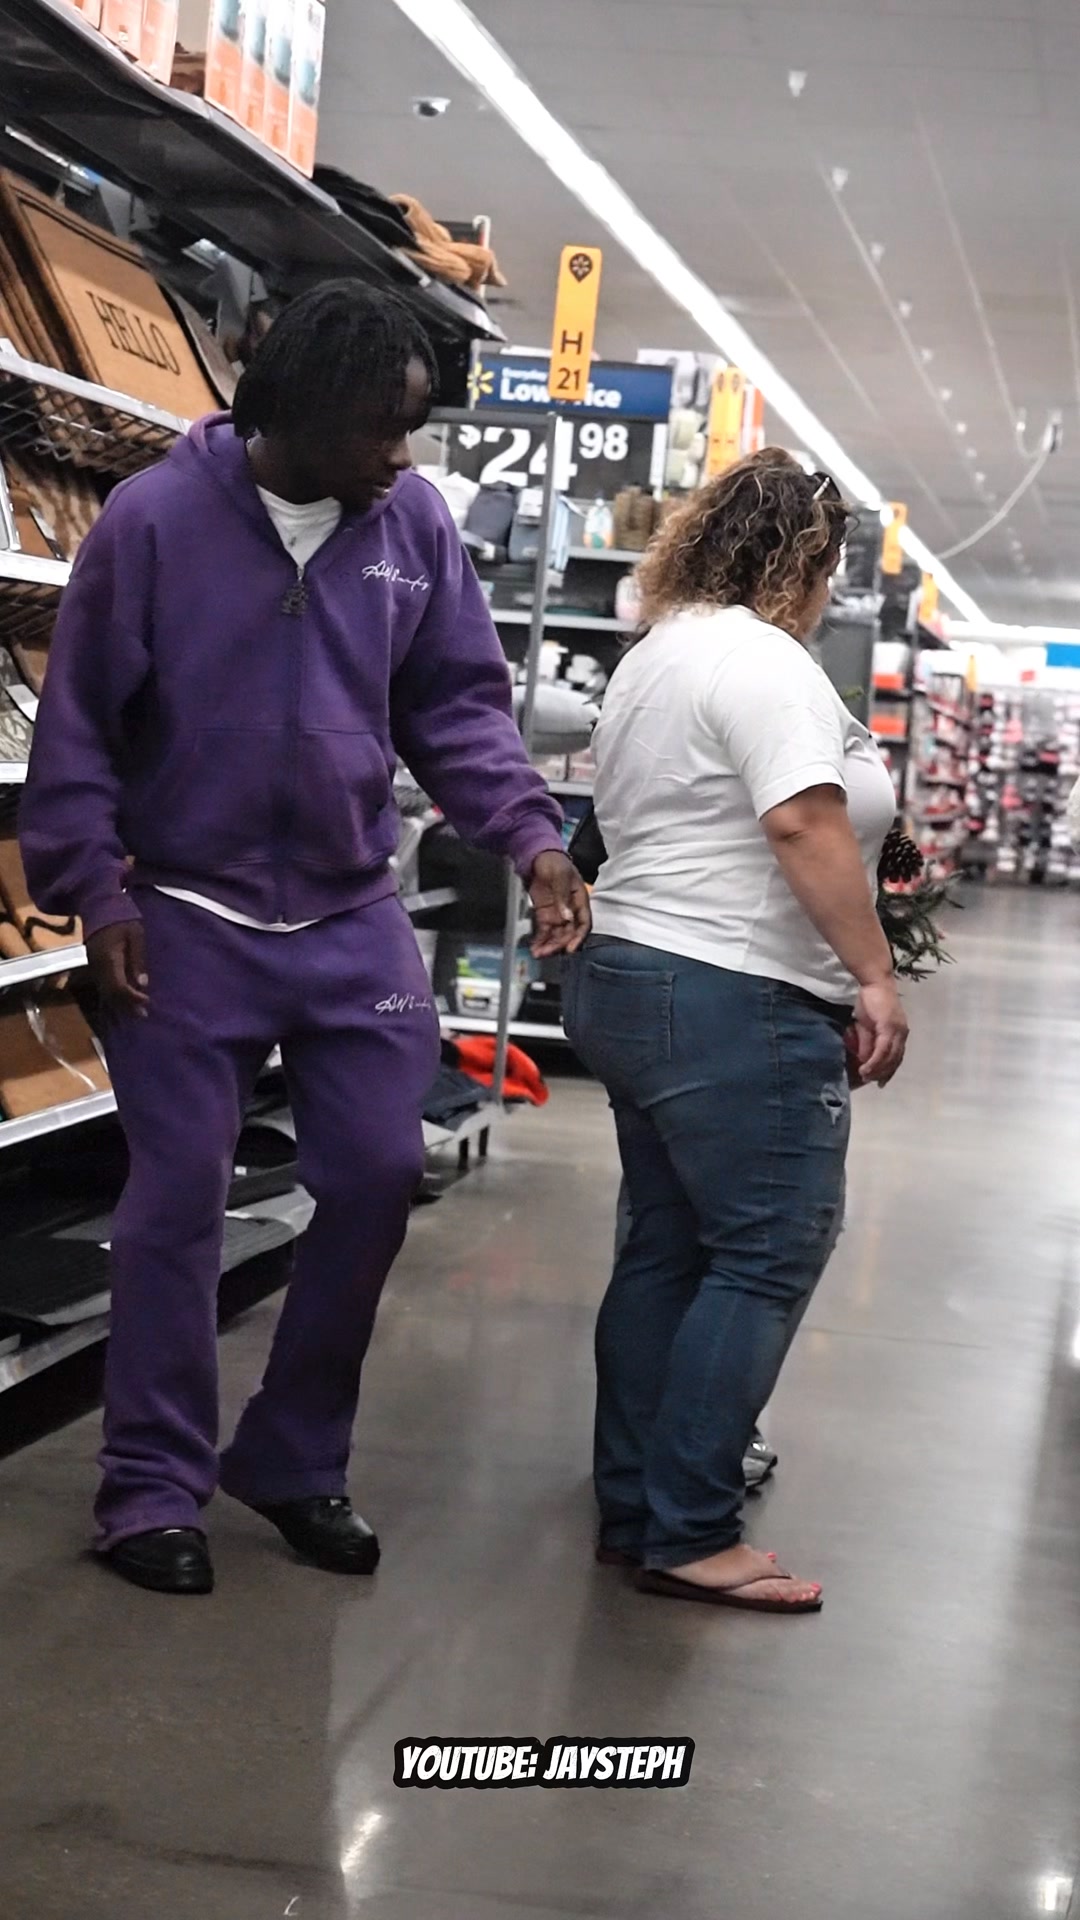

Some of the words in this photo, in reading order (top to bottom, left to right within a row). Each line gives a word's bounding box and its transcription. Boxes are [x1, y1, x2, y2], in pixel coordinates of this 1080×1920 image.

[86, 291, 181, 376] HELLO
[560, 330, 583, 355] H
[500, 378, 551, 403] Low
[556, 367, 581, 391] 21
